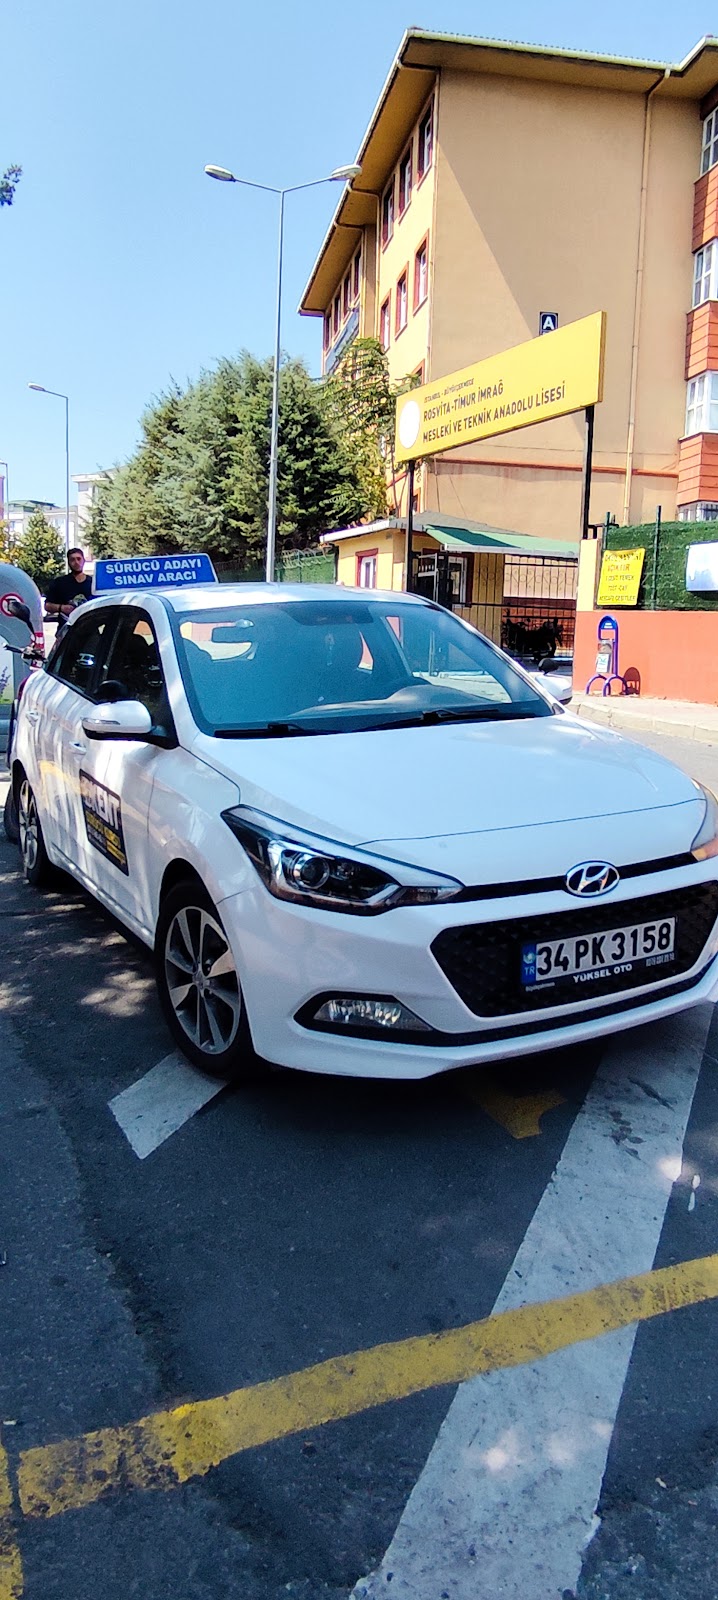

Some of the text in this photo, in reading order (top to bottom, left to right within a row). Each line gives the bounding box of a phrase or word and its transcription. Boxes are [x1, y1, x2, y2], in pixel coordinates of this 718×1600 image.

[543, 316, 555, 330] A
[424, 379, 504, 422] ROSVİTA-TİMUR İMRAĞ
[423, 380, 566, 443] MESLEKİ VE TEKNİK ANADOLU LİSESİ
[105, 558, 201, 574] SÜRÜCÜ ADAYI
[114, 571, 197, 586] SINAV ARACI
[536, 943, 569, 976] 34
[575, 935, 606, 969] PK
[611, 922, 671, 961] 3158
[524, 965, 535, 976] TR
[573, 963, 632, 983] YÜKSEL OTO
